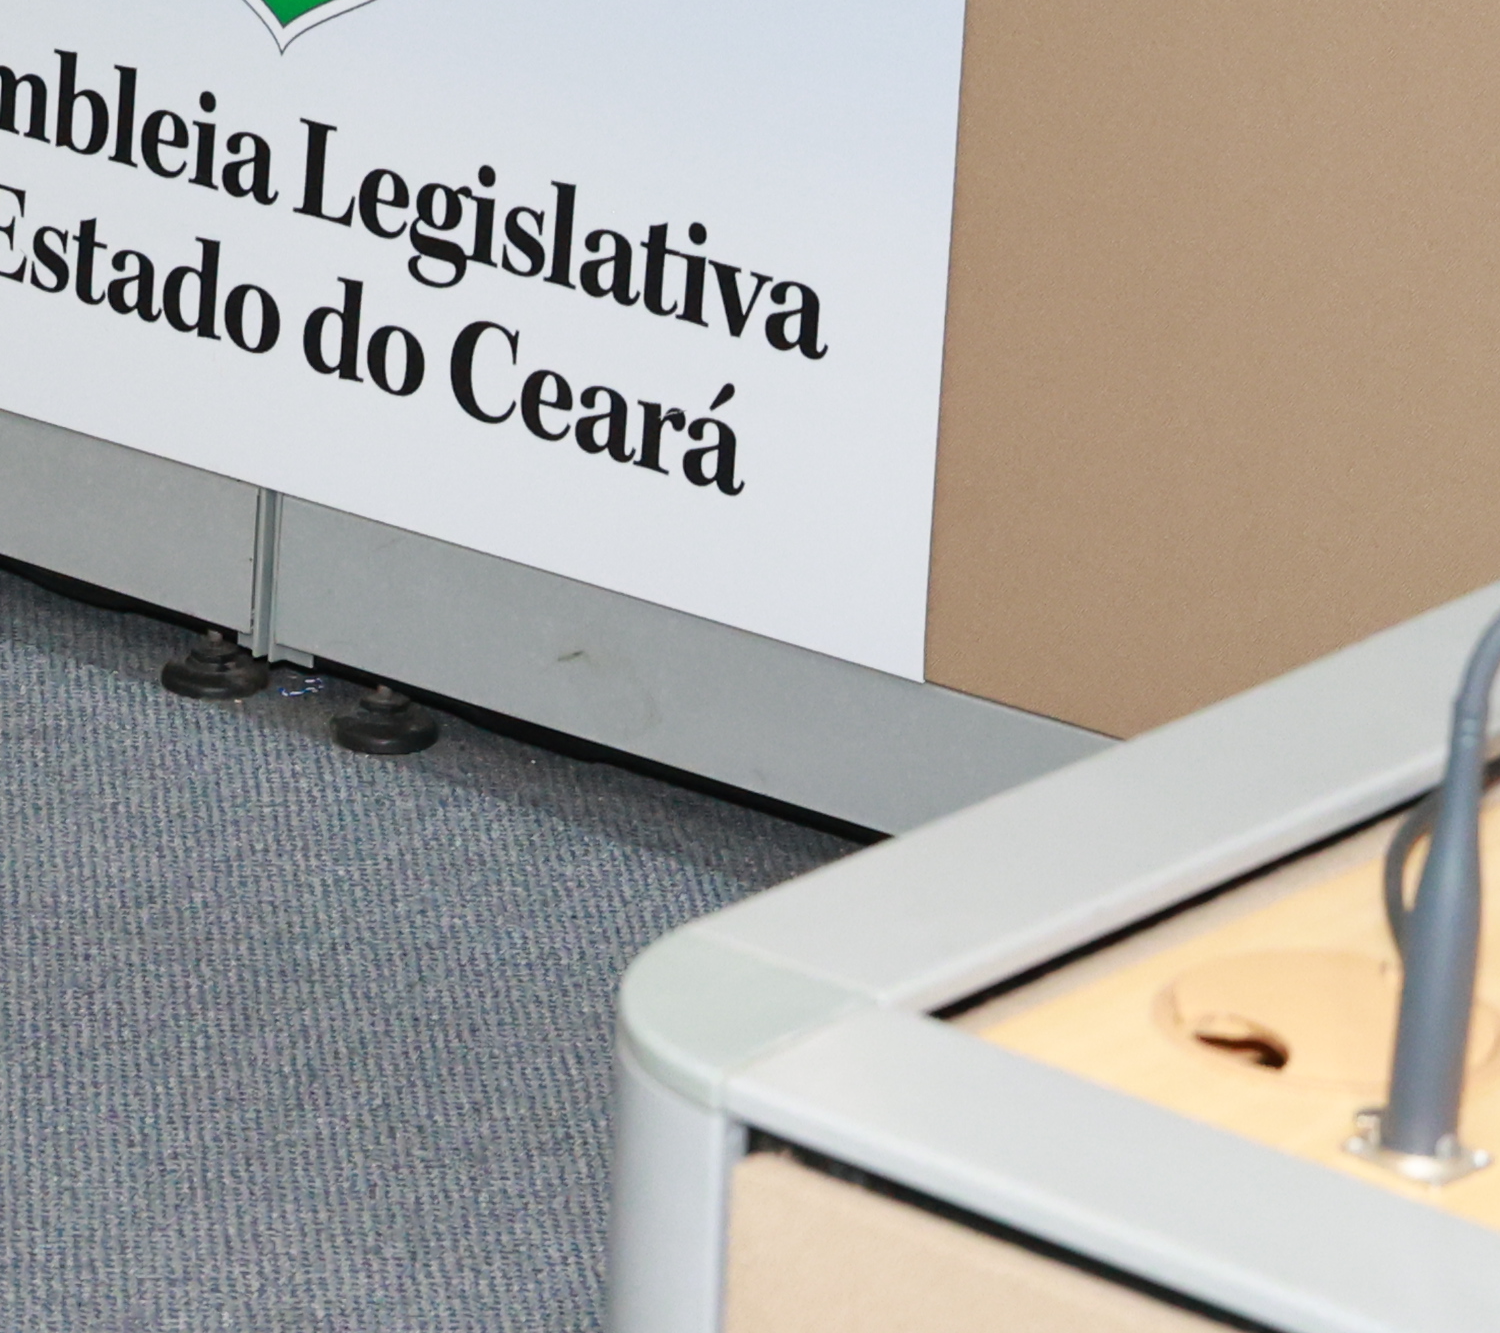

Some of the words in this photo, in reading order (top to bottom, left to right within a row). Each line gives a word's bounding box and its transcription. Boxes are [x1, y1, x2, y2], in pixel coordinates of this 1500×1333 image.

[293, 118, 828, 360] Legislativa
[303, 278, 426, 396] do
[450, 321, 745, 496] Ceará
